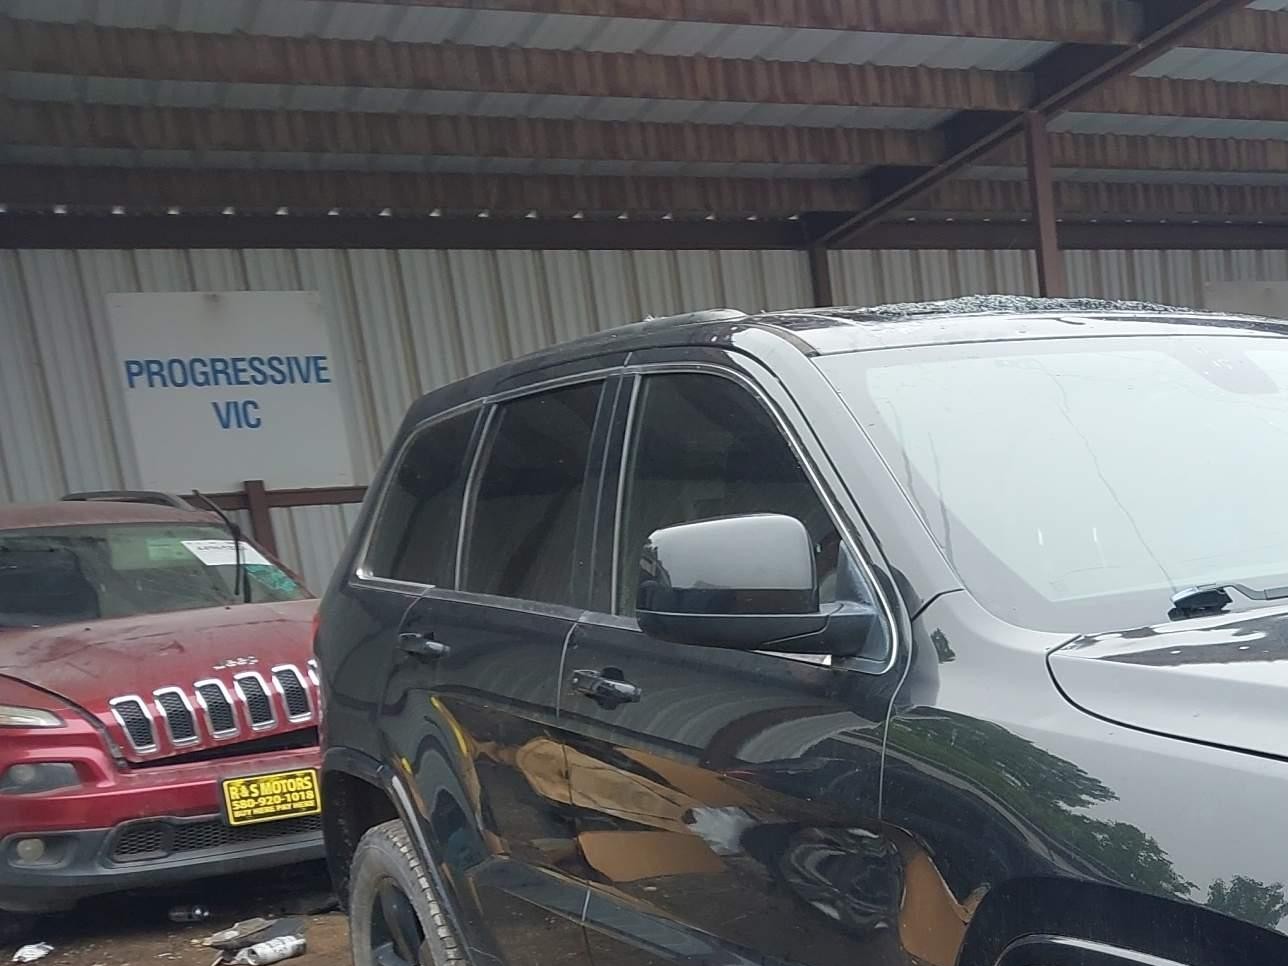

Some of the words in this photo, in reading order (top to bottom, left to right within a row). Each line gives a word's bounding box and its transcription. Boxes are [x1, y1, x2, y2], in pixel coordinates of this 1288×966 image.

[124, 355, 332, 389] PROGRESSIVE
[211, 399, 262, 429] VIC
[260, 776, 313, 796] MOTORS
[231, 791, 315, 810] 580-920-1018
